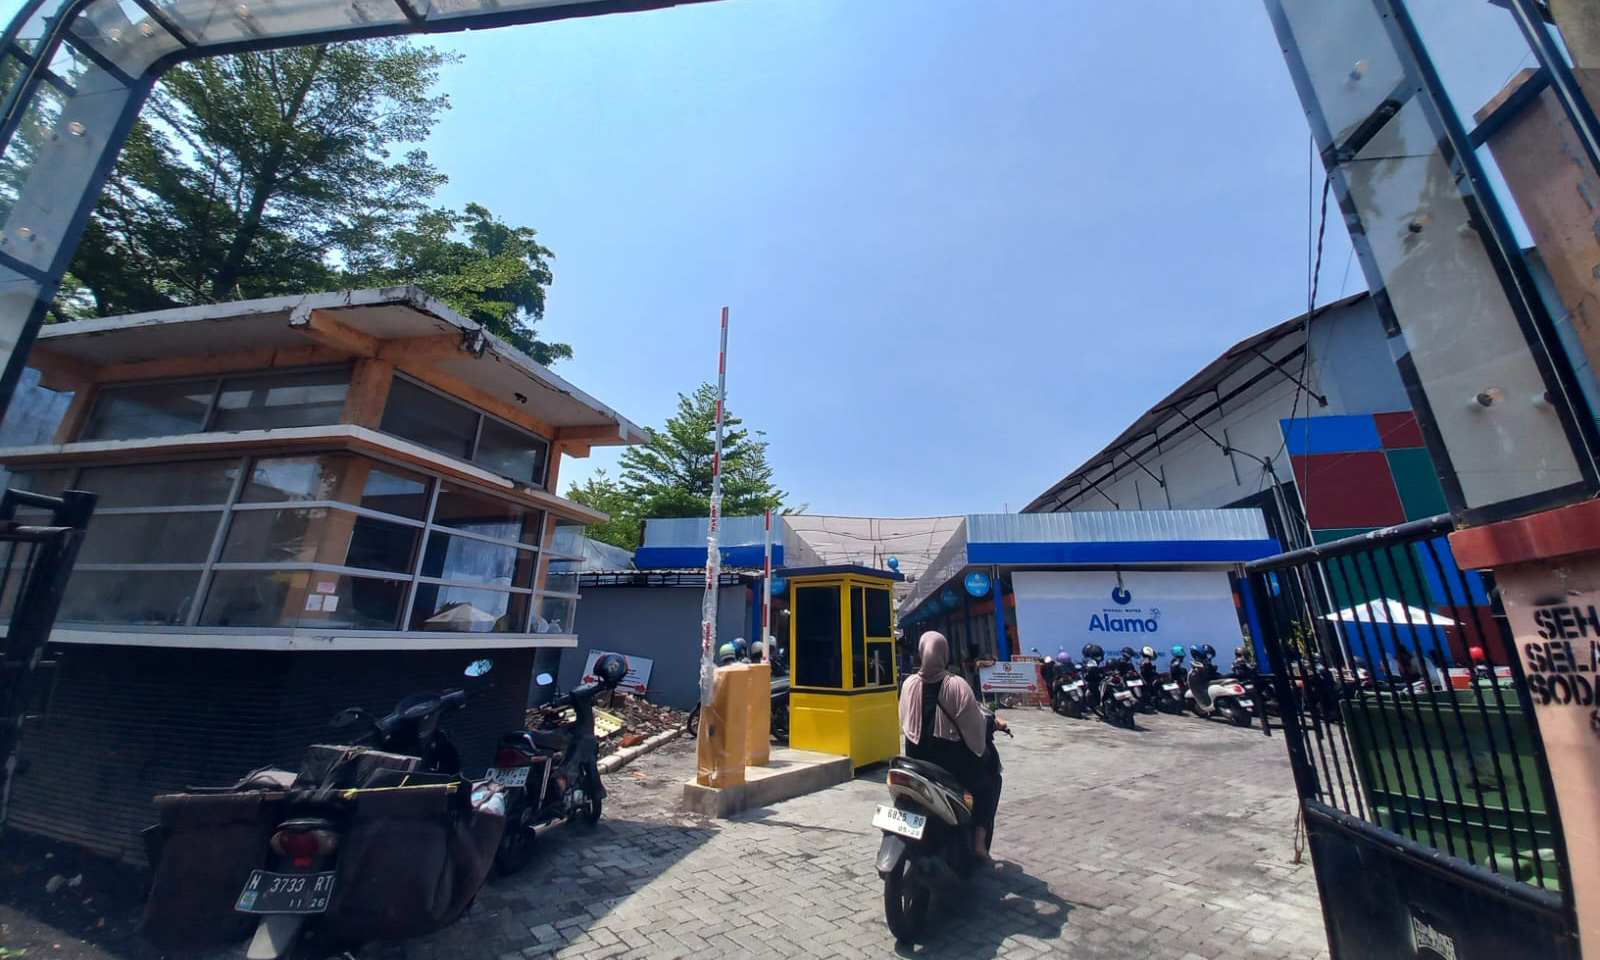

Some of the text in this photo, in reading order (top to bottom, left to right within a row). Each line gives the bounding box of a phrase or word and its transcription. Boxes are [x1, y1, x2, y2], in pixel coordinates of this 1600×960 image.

[1089, 613, 1158, 632] Alamo
[1534, 605, 1600, 639] SEH
[888, 809, 907, 821] 6825
[248, 874, 334, 892] N 3733 RT
